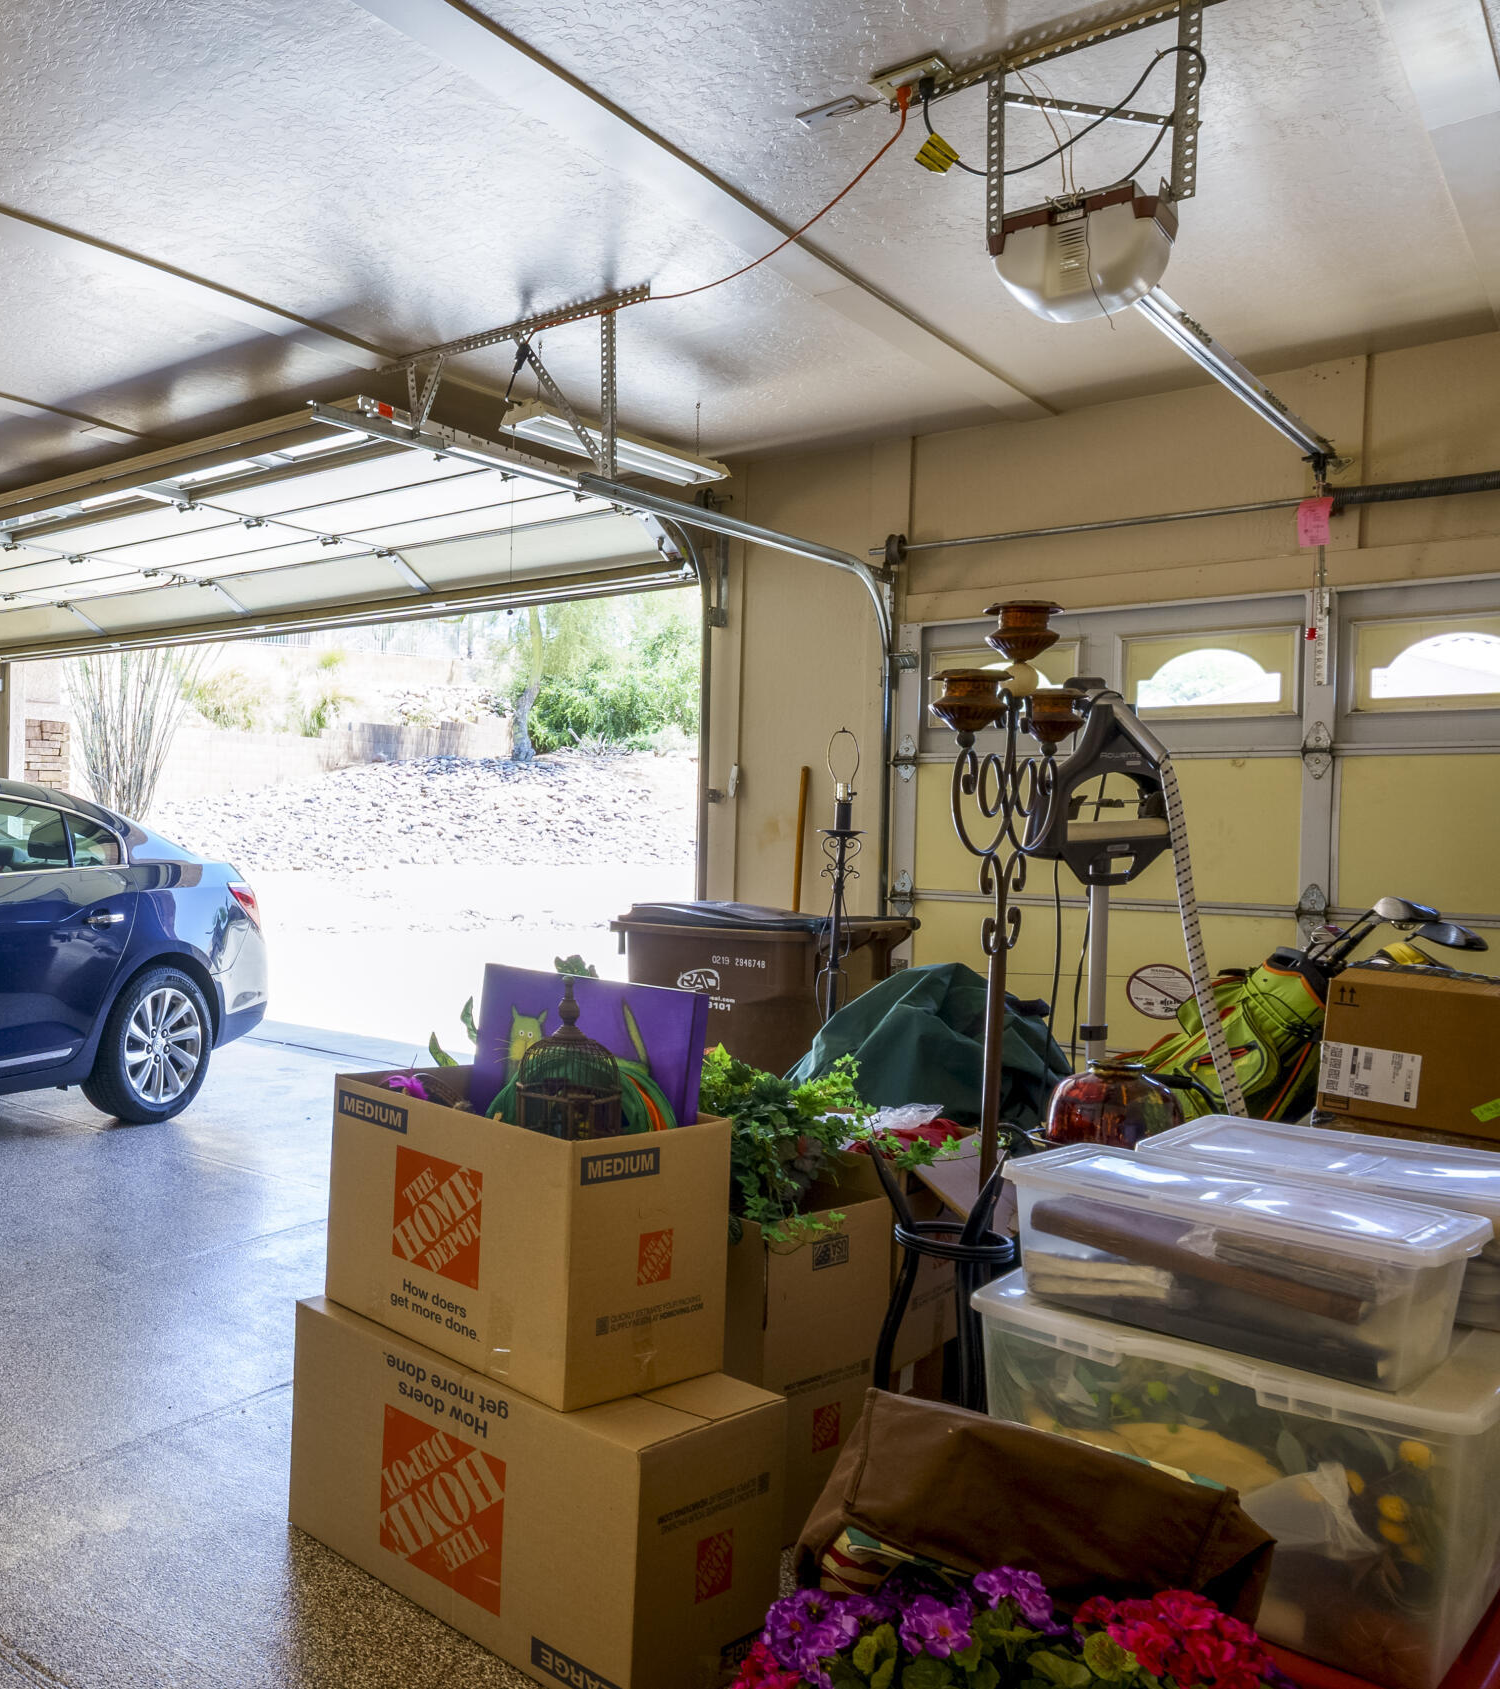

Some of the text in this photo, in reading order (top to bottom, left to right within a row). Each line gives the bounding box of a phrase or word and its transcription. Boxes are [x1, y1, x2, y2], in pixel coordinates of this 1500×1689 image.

[343, 1095, 403, 1128] MEDIUM
[402, 1166, 439, 1207] THE
[587, 1153, 654, 1180] MEDIUM
[392, 1165, 483, 1263] HOME
[424, 1213, 482, 1274] DEPOT
[390, 1292, 410, 1310] get
[411, 1302, 443, 1324] more
[402, 1278, 467, 1319] How doers
[398, 1381, 488, 1439] How doers
[430, 1374, 475, 1405] more
[478, 1394, 509, 1420] get
[381, 1430, 456, 1499] DEPOT
[380, 1449, 506, 1559] HOME
[436, 1524, 490, 1573] THE
[540, 1647, 611, 1689] ARGE
